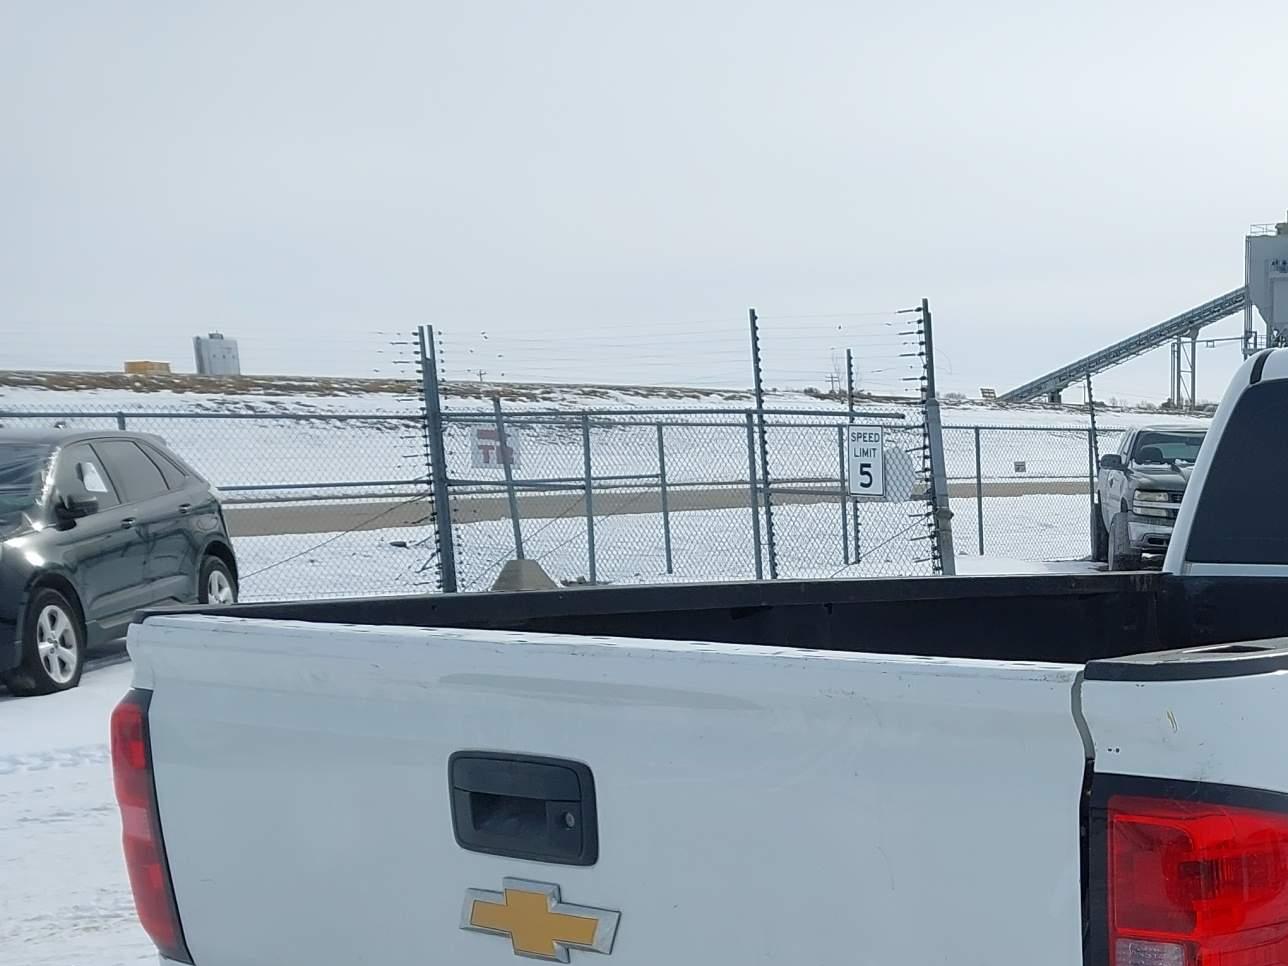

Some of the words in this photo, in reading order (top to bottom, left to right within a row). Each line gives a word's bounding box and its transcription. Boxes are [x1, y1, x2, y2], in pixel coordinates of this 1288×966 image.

[851, 432, 880, 443] SPEED
[853, 447, 877, 458] LIMIT
[859, 462, 873, 488] 5
